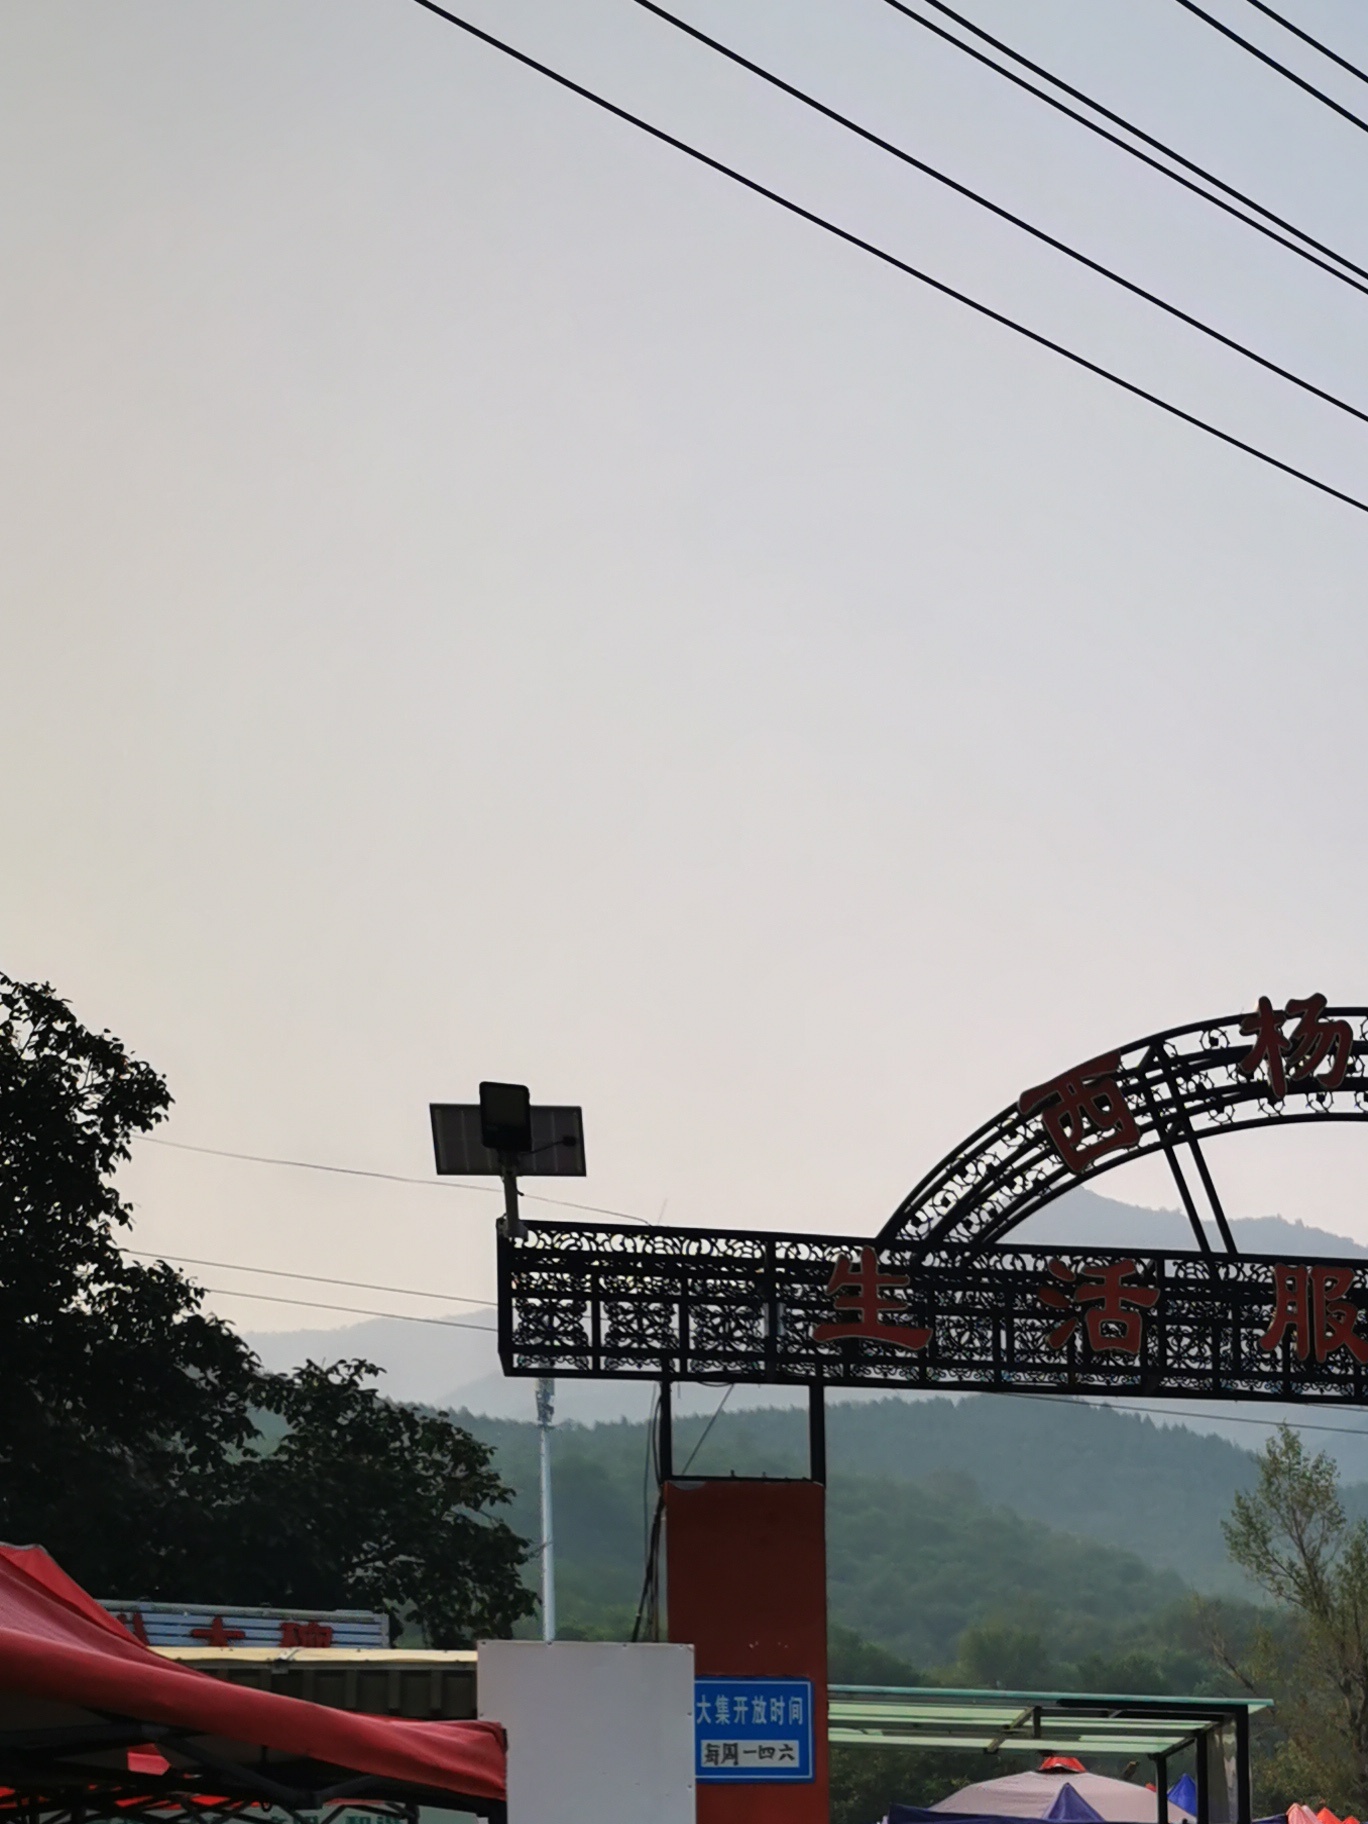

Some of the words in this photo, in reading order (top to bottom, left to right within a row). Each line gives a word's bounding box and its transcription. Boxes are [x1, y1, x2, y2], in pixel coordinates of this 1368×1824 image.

[696, 1694, 804, 1726] 大集开放时间
